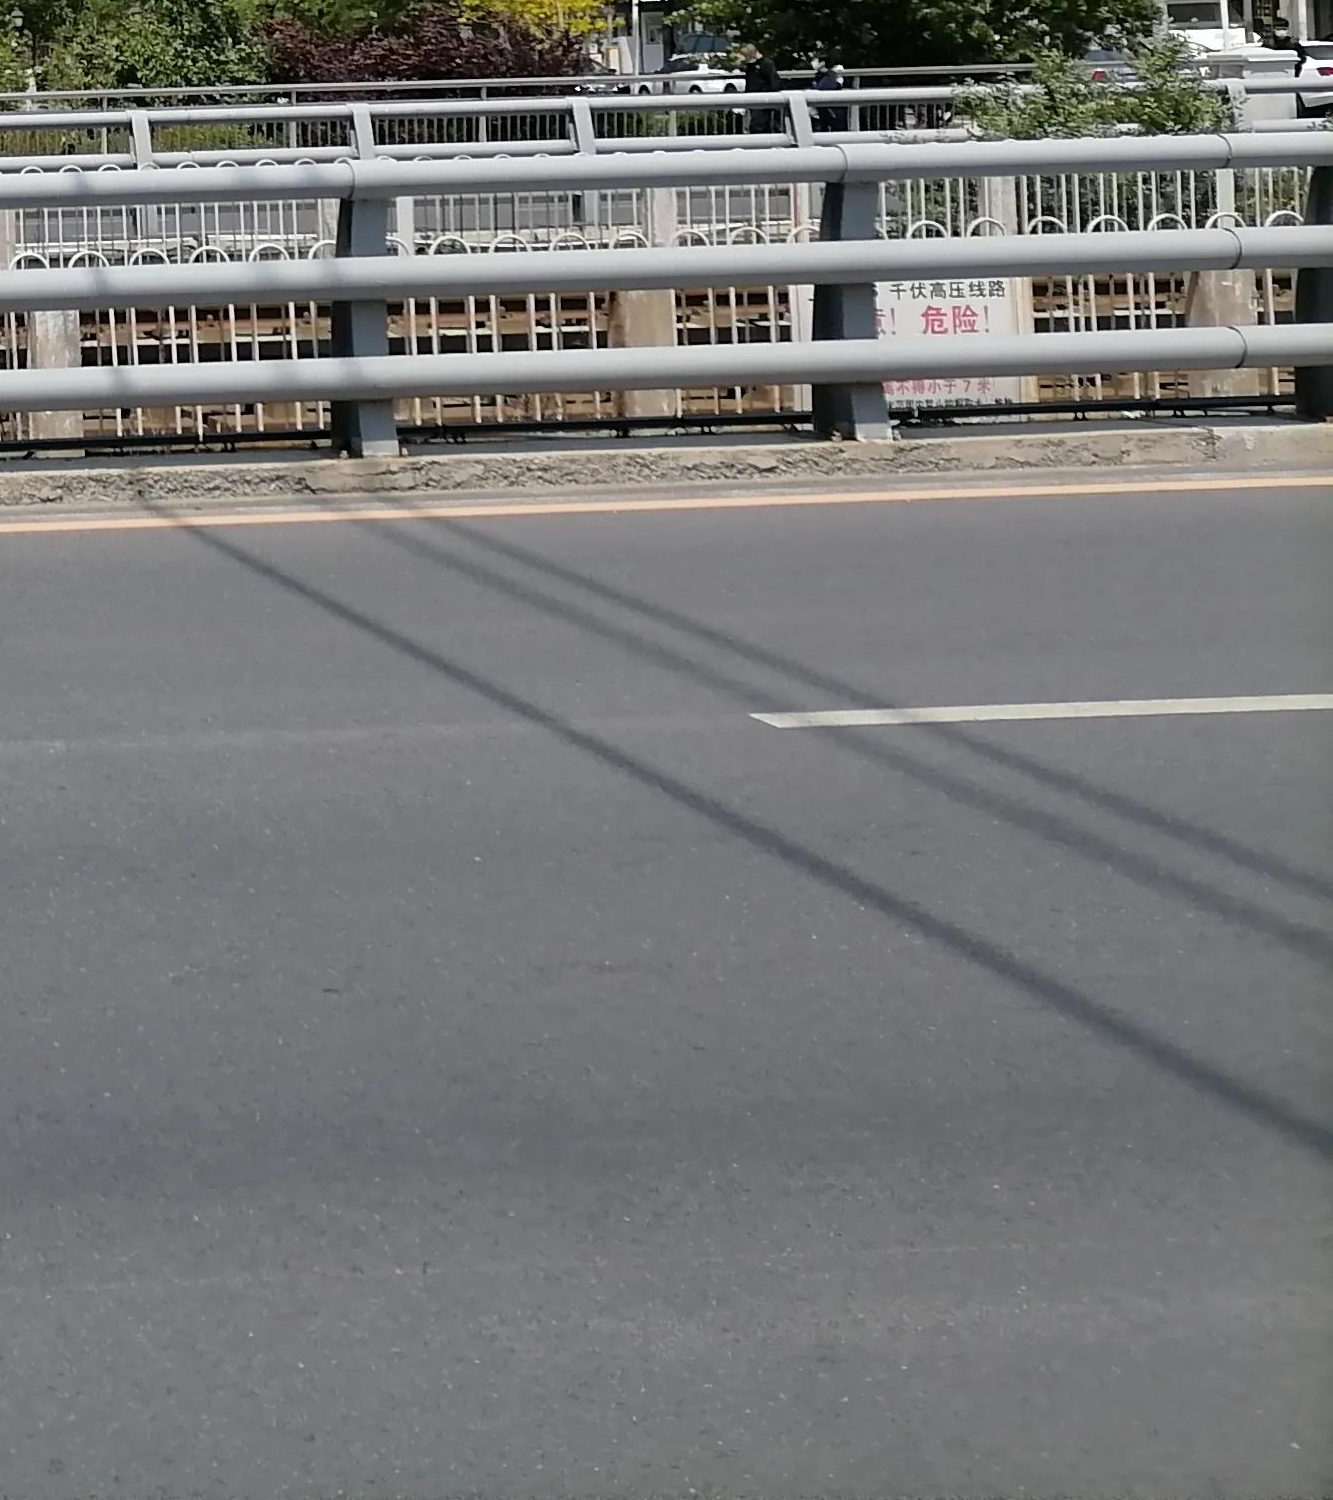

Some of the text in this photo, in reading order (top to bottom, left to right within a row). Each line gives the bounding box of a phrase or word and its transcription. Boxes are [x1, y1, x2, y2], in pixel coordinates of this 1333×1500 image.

[889, 280, 1006, 300] 千伏高压线路
[920, 304, 989, 335] 危险！
